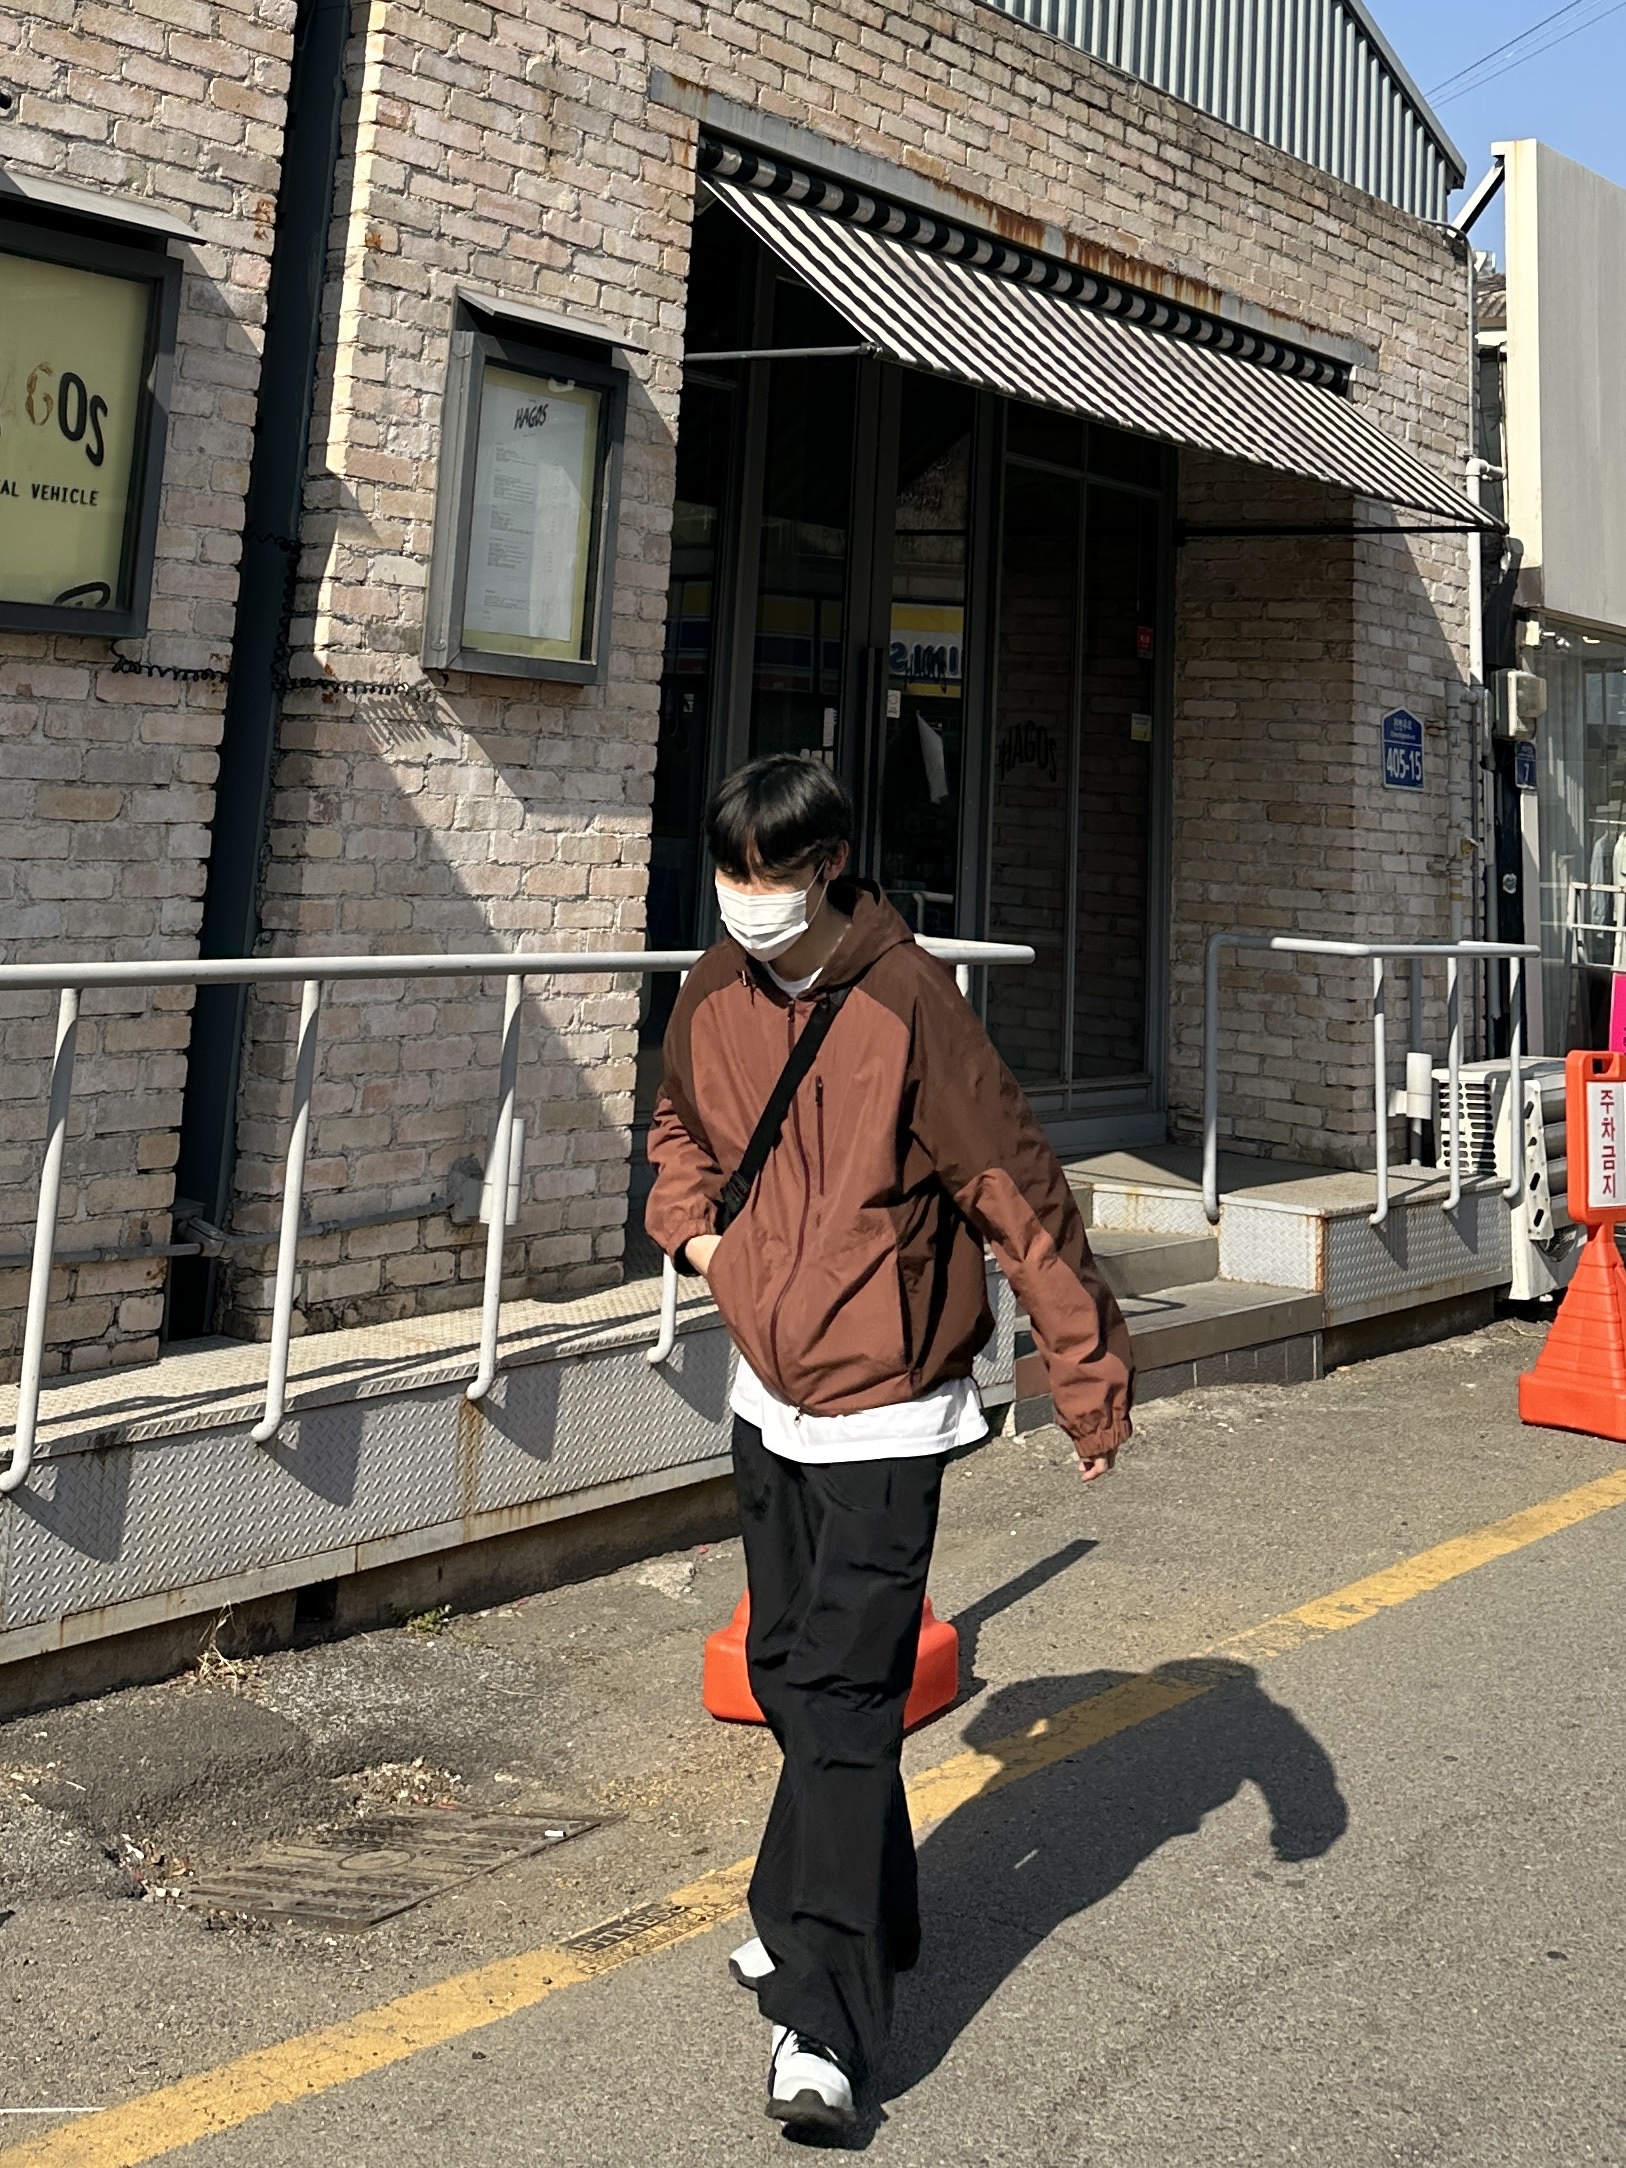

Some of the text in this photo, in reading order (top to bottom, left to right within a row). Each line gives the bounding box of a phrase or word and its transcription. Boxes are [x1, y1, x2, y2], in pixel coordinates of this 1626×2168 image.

[513, 402, 550, 431] HAGOS
[31, 482, 100, 507] VEHICLE
[997, 720, 1058, 783] HAGOS
[1386, 746, 1423, 782] 405-15
[1599, 1089, 1617, 1199] 주차금지
